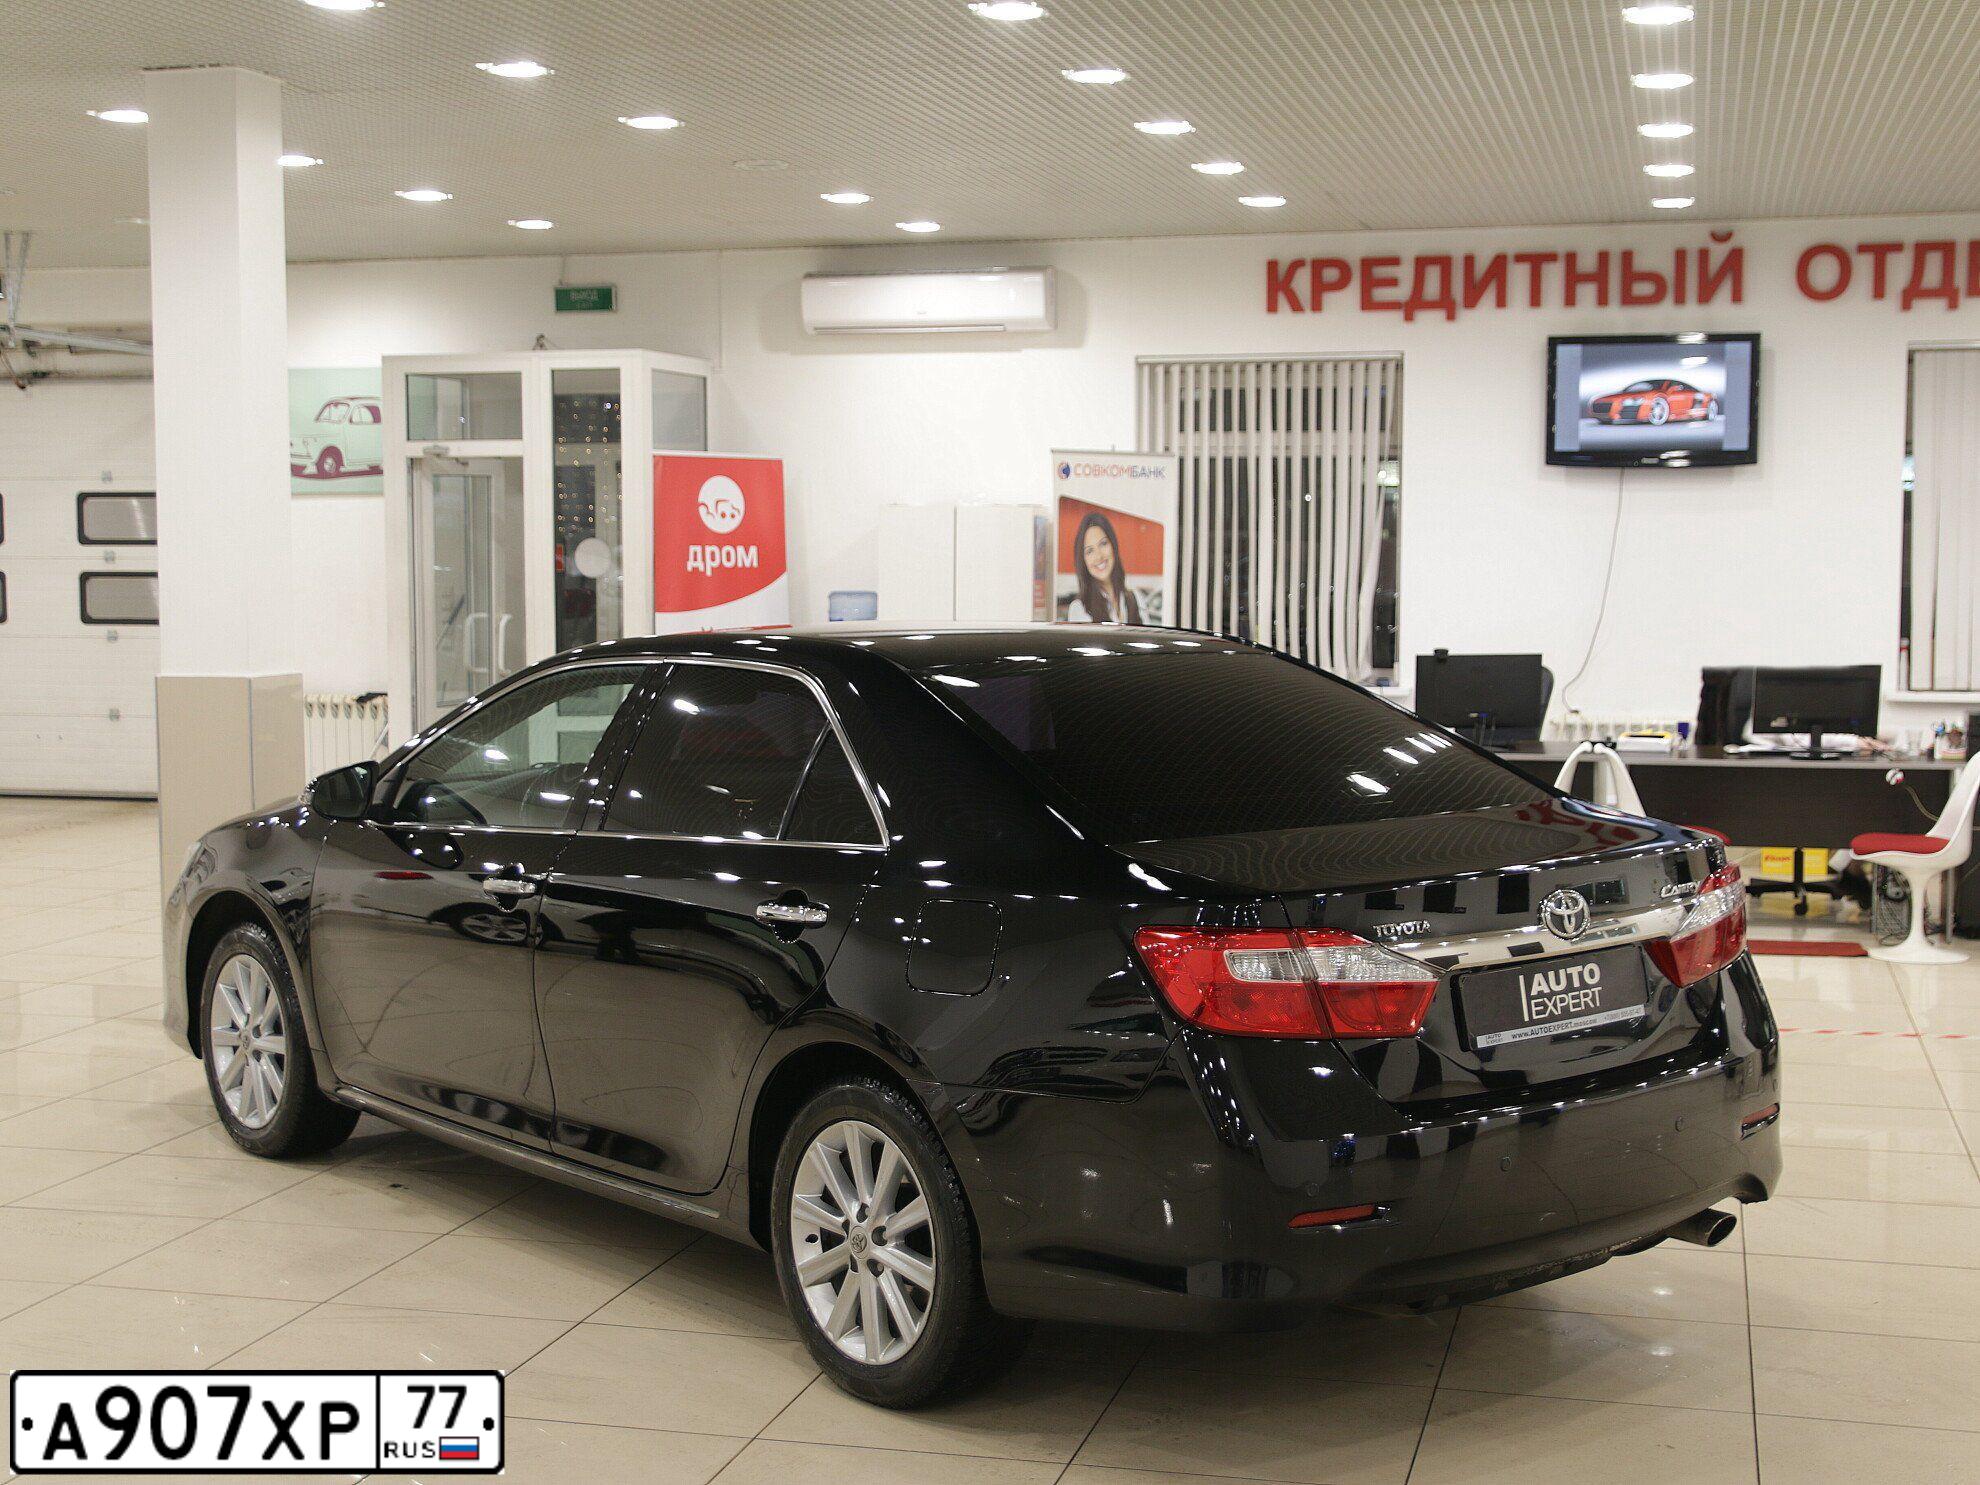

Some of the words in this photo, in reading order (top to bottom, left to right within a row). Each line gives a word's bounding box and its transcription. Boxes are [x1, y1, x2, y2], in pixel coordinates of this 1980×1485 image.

[1266, 231, 1744, 322] КРЕДИТНЫЙ
[1073, 462, 1168, 480] СОВКОМБАНК
[686, 544, 759, 576] дром
[1372, 920, 1432, 938] TOYOTA
[1530, 962, 1601, 996] AUTO
[1530, 986, 1603, 1020] EXPERT
